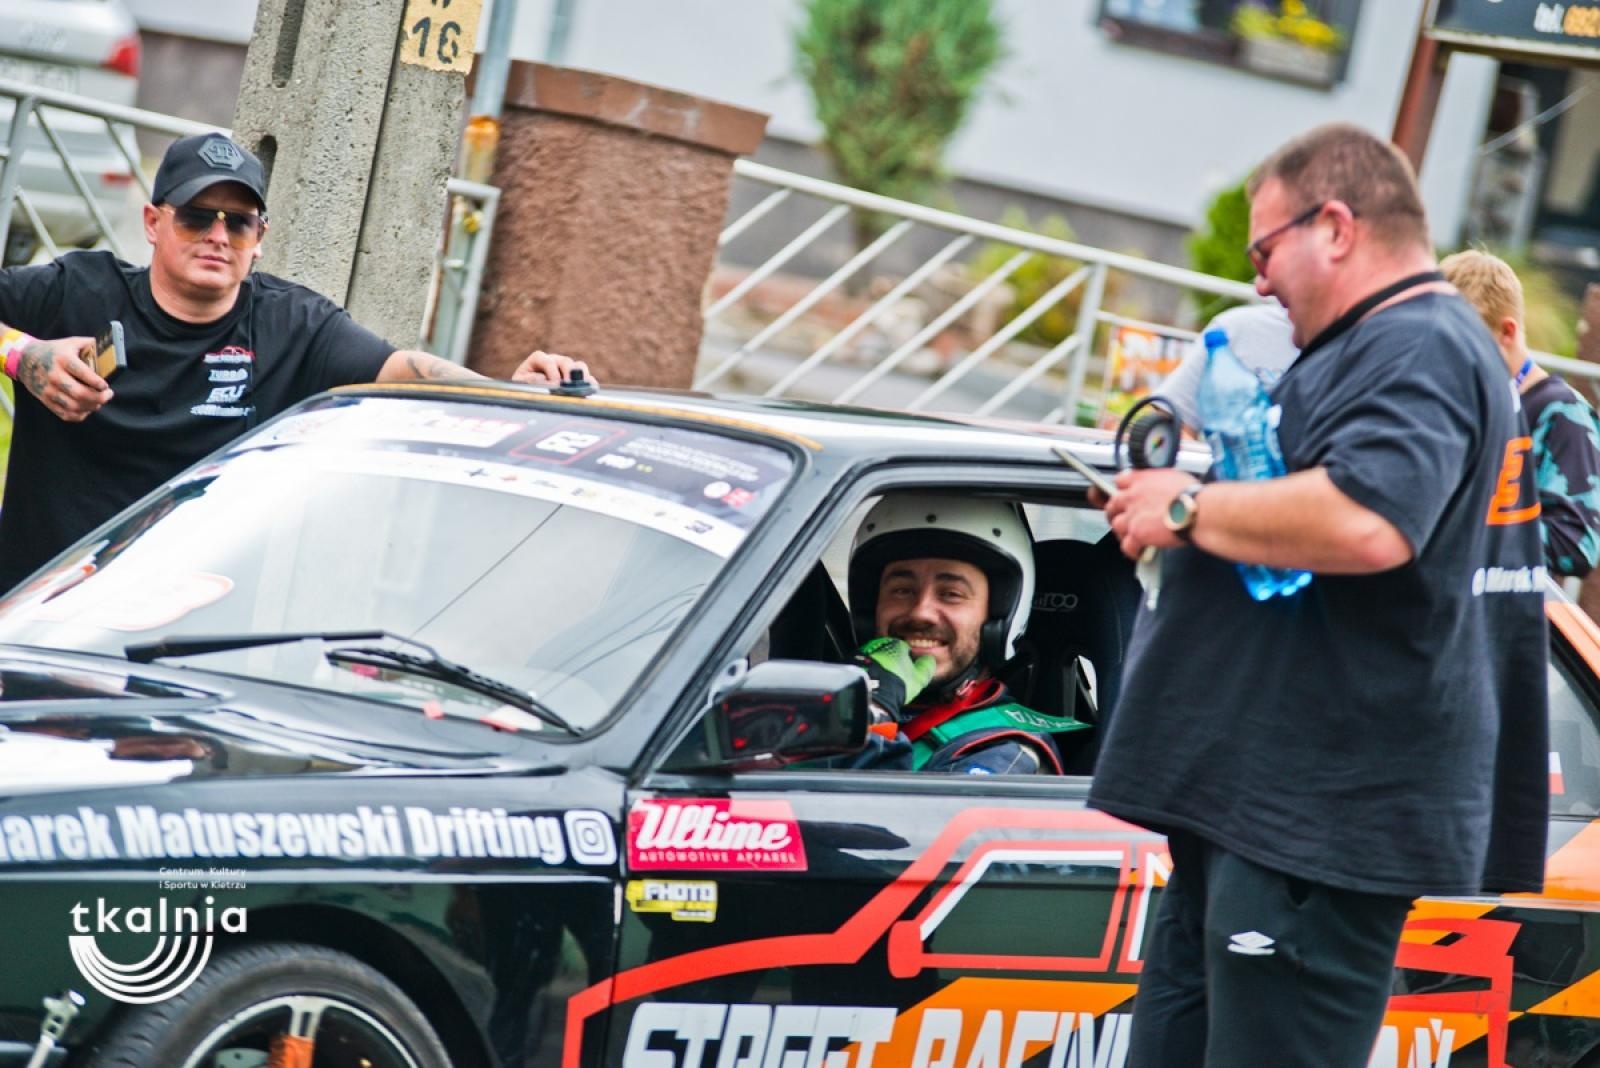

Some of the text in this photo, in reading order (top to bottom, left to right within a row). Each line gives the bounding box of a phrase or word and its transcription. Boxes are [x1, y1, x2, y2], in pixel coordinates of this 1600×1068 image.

[412, 16, 461, 64] 16
[0, 805, 567, 865] arek Matuszewski Drifting
[632, 798, 792, 850] Ultime
[639, 851, 796, 863] AUTOMOTIVE APPAREL
[645, 880, 714, 901] PHOTO
